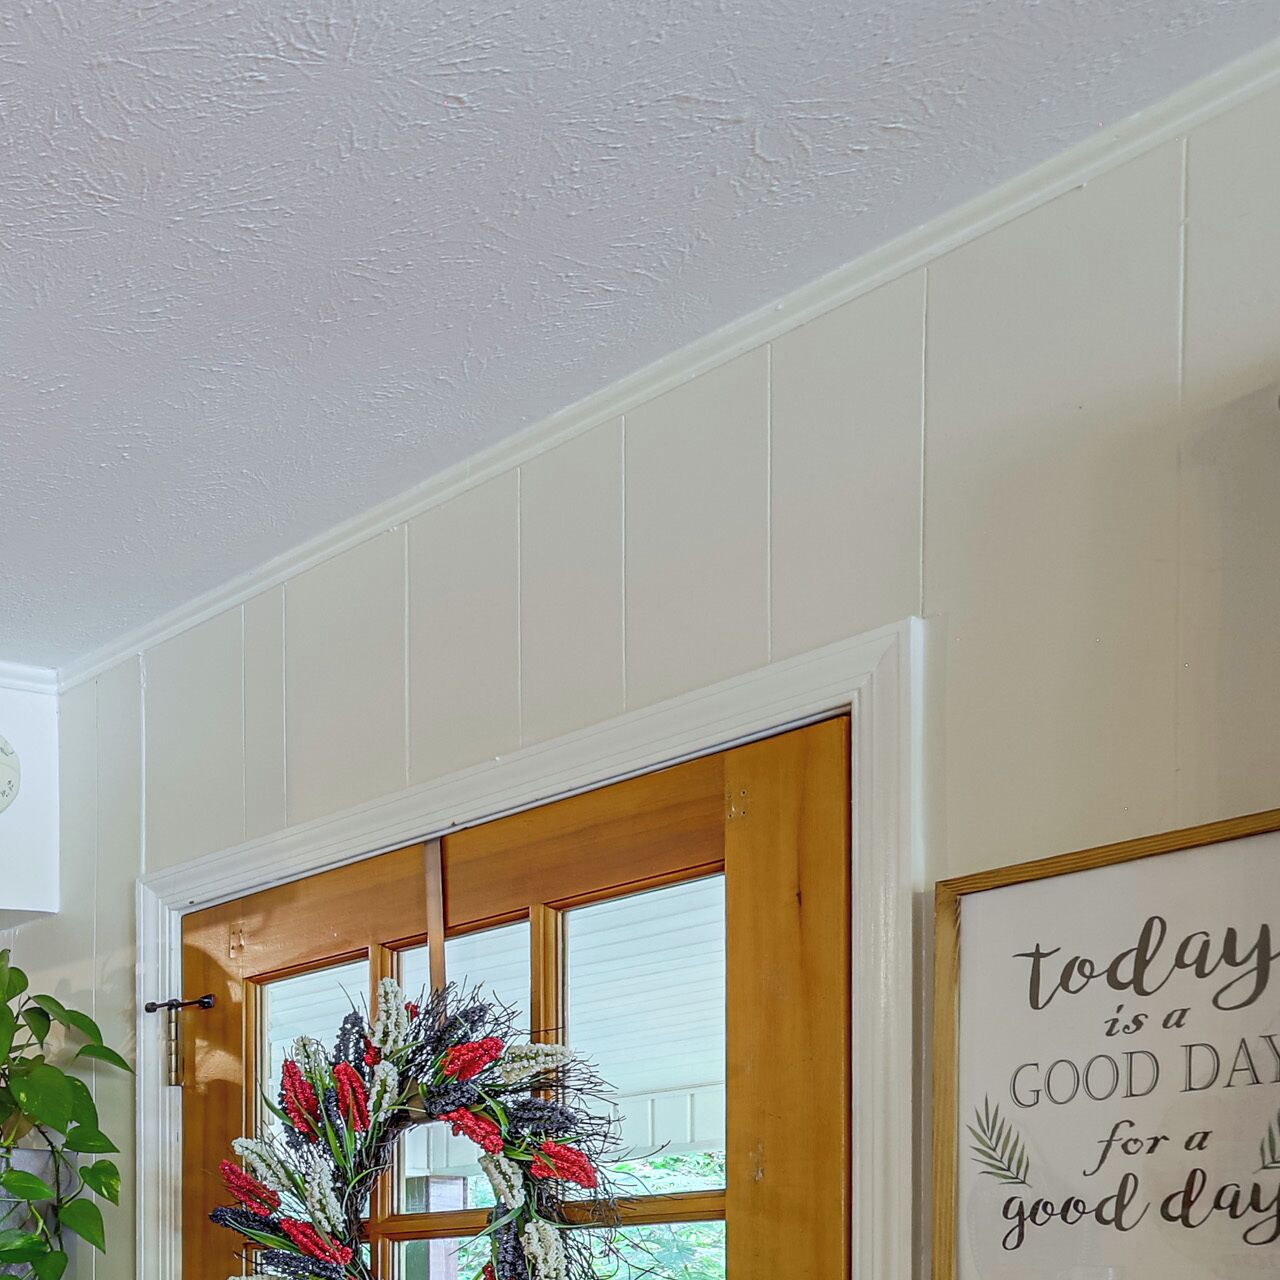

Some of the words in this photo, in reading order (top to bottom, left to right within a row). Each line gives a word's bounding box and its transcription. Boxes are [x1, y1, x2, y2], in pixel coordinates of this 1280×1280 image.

[1012, 916, 1280, 1010] today
[1104, 1004, 1148, 1036] is
[1162, 1007, 1191, 1029] a
[1009, 1050, 1159, 1108] GOOD
[1083, 1120, 1169, 1177] for
[1184, 1130, 1213, 1151] a
[1002, 1173, 1150, 1250] good
